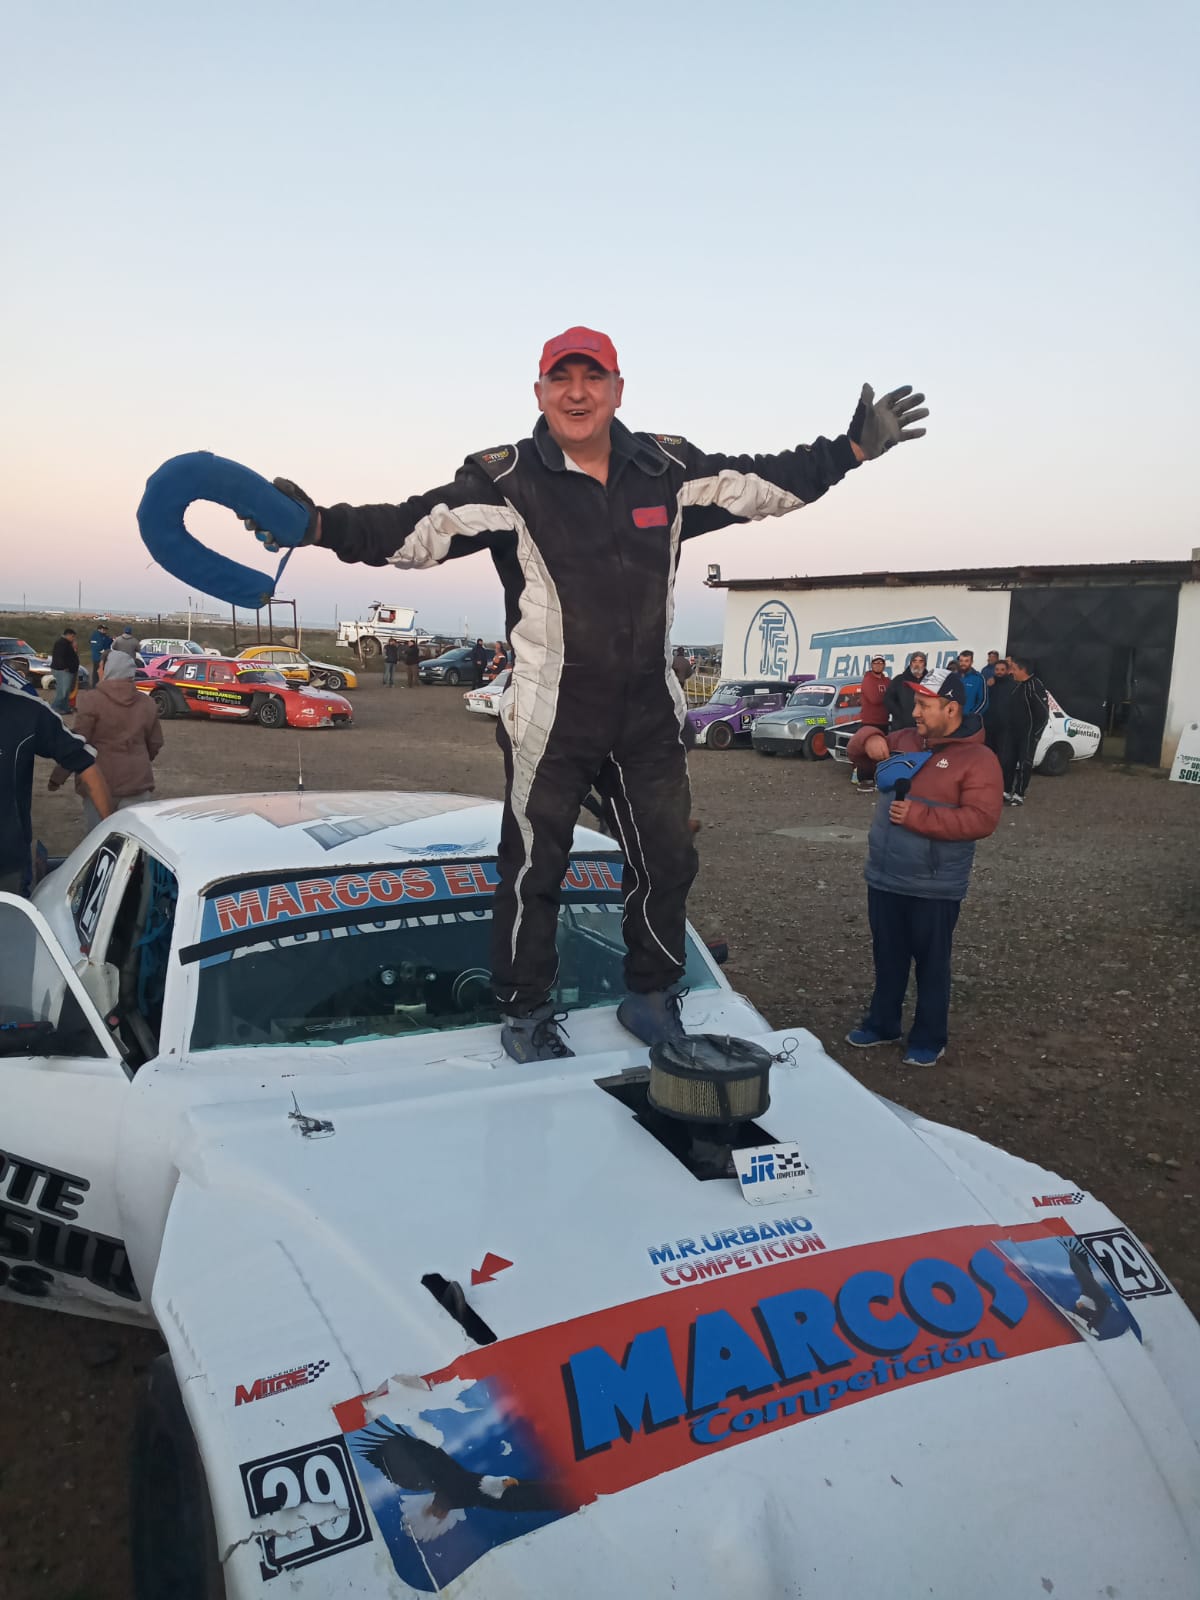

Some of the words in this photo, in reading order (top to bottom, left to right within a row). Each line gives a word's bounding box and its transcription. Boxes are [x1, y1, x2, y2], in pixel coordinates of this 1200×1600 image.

[185, 666, 198, 679] 5
[215, 868, 436, 932] MARCOS
[442, 863, 498, 896] EL
[741, 1153, 776, 1185] JR
[660, 1233, 827, 1286] COMPETICION
[1092, 1237, 1156, 1292] 29
[561, 1247, 1029, 1462] MARCOS
[690, 1337, 1006, 1444] Competición
[262, 1454, 350, 1560] 29
